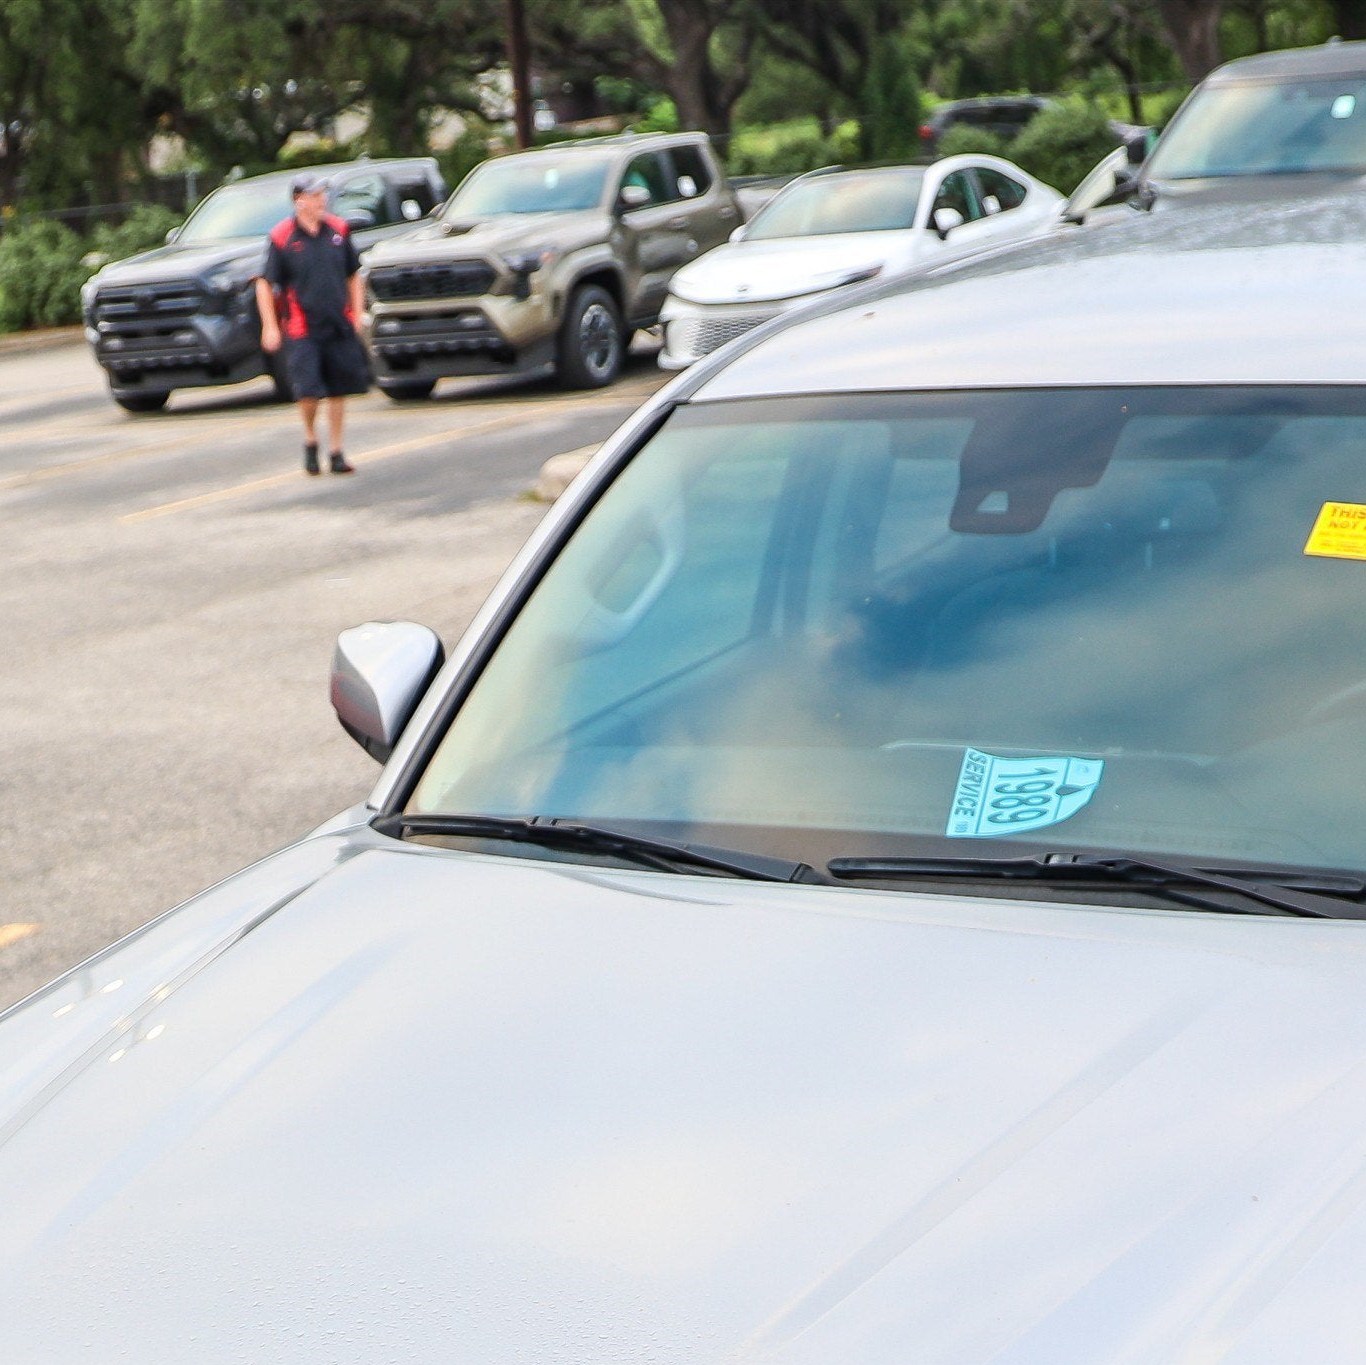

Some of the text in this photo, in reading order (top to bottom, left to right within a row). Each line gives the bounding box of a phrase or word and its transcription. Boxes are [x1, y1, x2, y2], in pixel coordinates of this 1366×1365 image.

[1329, 520, 1357, 530] NOT
[954, 752, 987, 817] SERVICE
[986, 766, 1059, 824] 1989
